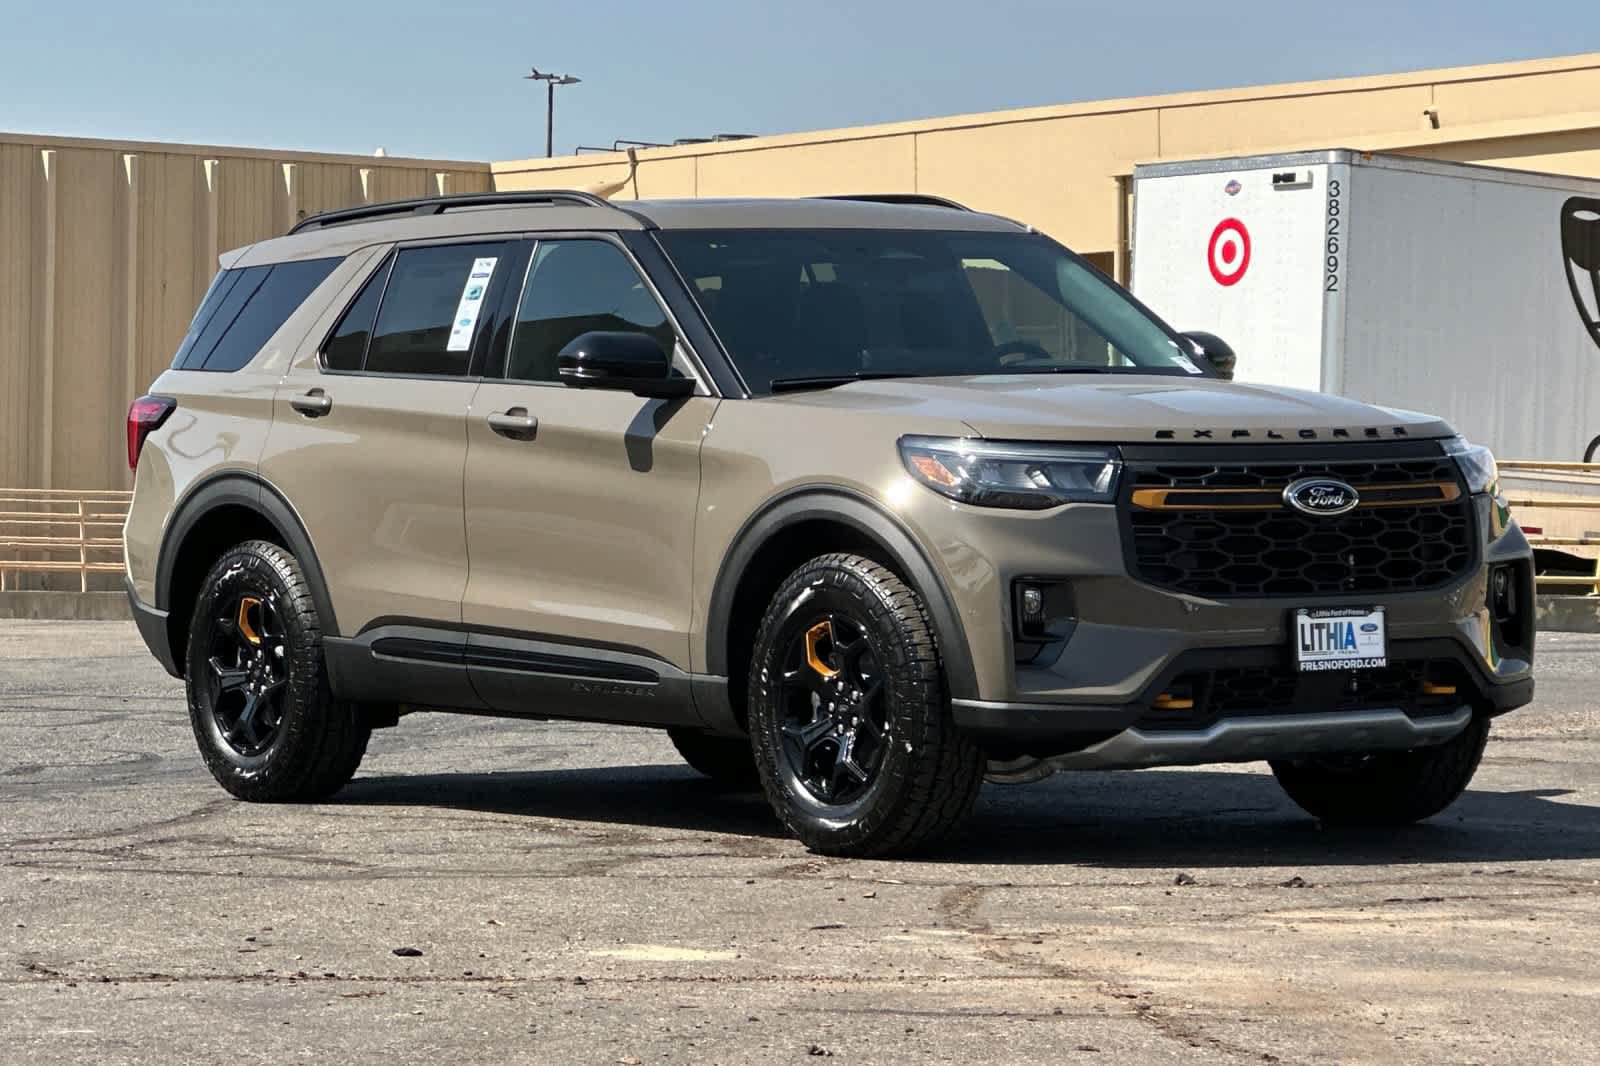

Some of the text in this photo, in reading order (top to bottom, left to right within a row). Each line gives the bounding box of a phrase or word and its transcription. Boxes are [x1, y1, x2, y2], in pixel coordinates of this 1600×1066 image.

[1326, 180, 1340, 292] 382692
[1308, 486, 1345, 506] Ford
[1300, 621, 1357, 651] LITHIA
[1300, 658, 1387, 672] FRESNOFORD.COM
